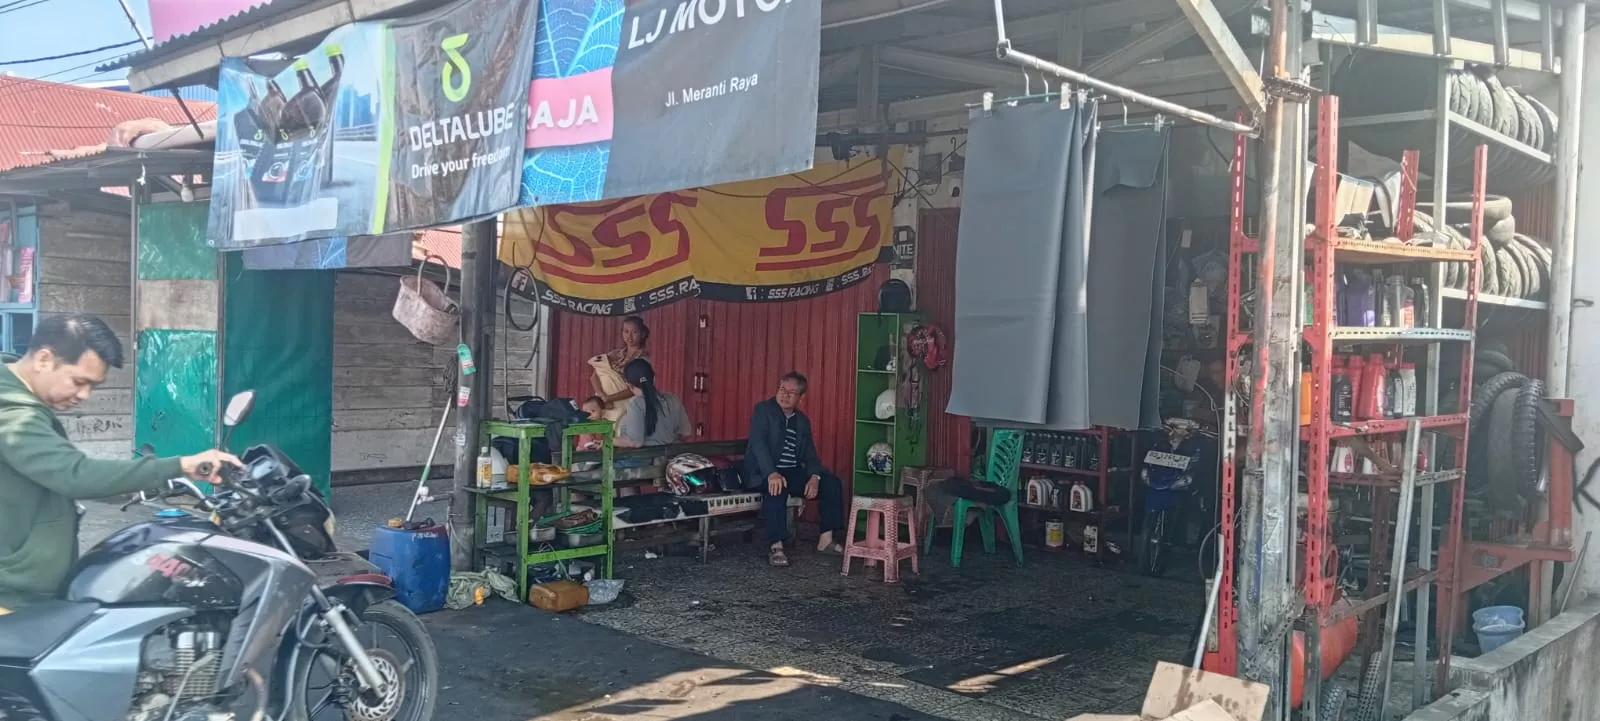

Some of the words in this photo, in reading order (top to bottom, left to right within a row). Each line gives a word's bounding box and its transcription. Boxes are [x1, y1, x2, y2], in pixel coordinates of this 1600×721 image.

[628, 9, 667, 49] LJ
[665, 91, 679, 107] Jl.
[683, 80, 726, 103] Meranti
[730, 73, 758, 93] Raya
[409, 102, 515, 151] DELTALUBE
[412, 161, 439, 179] Drive
[441, 157, 469, 177] your
[472, 146, 511, 168] freedom
[755, 167, 894, 272] SSS
[567, 300, 613, 315] RACING
[787, 283, 820, 298] RACING
